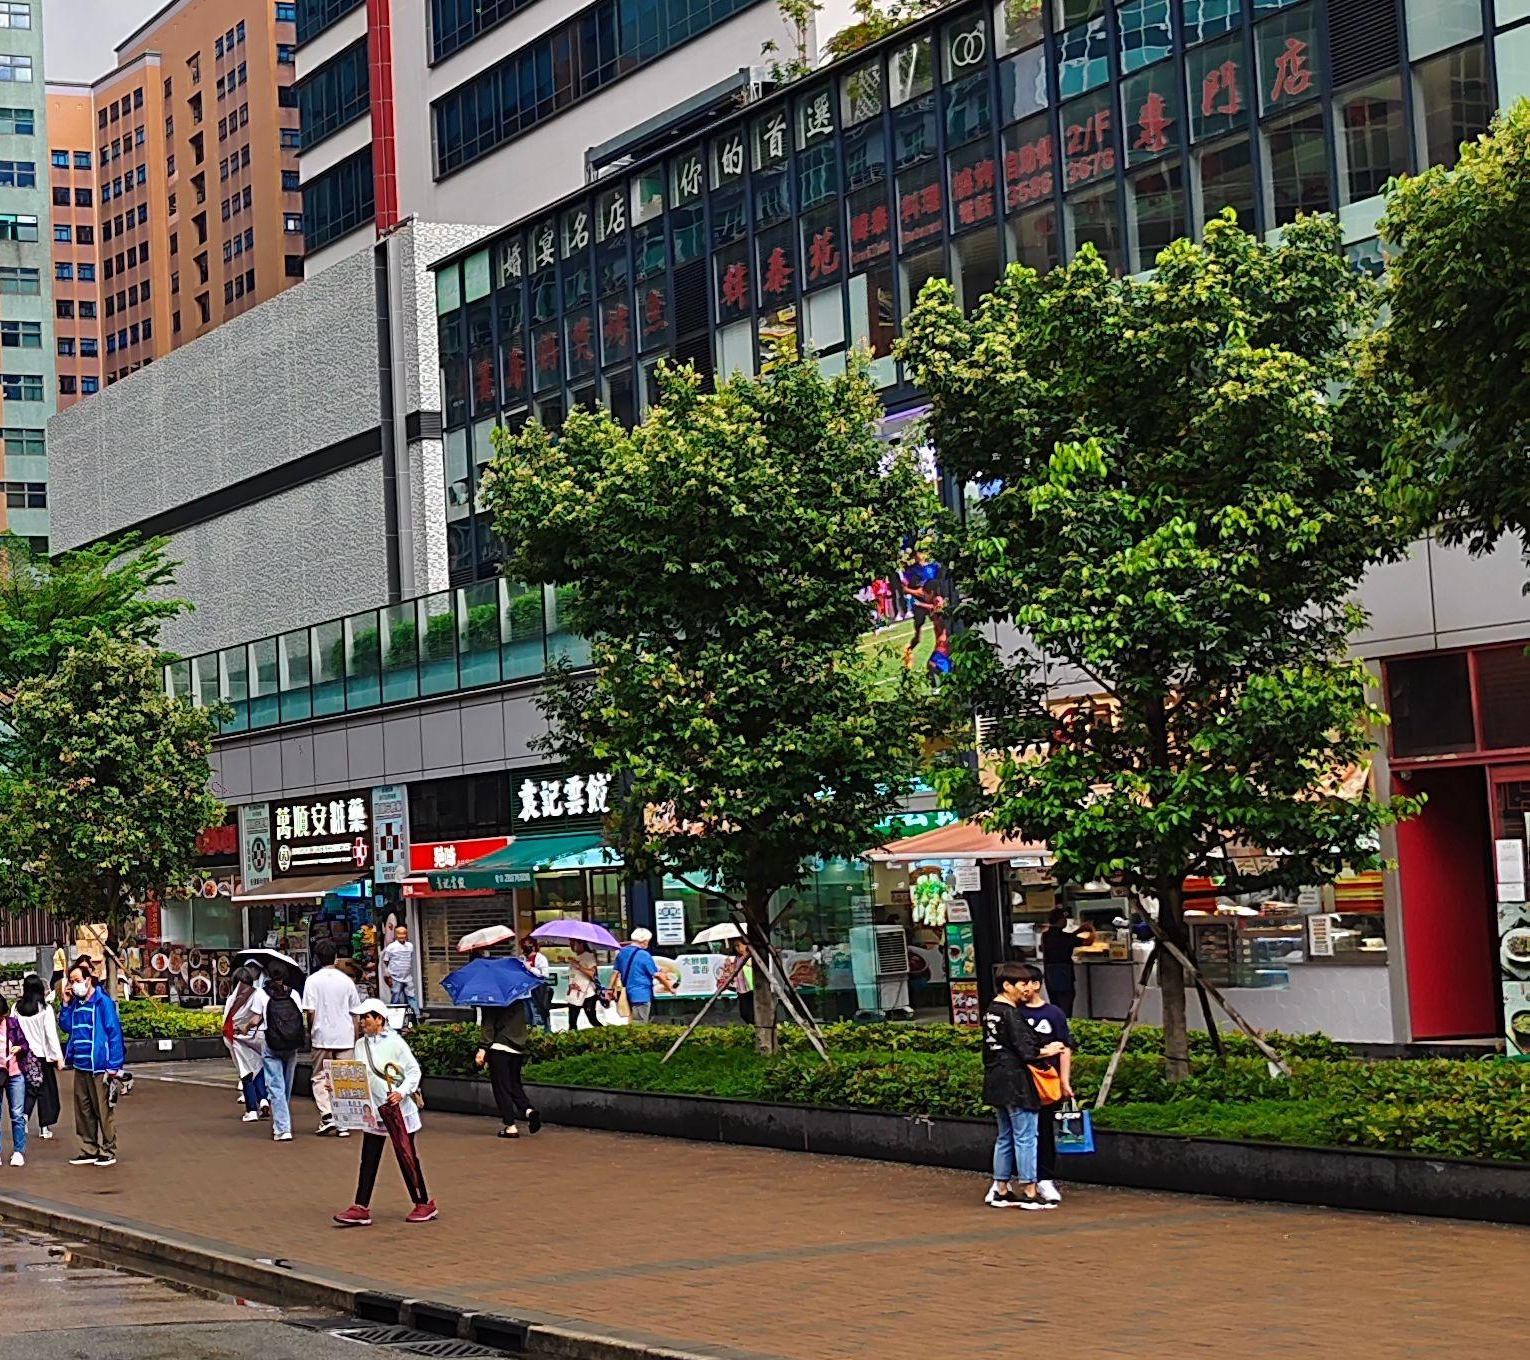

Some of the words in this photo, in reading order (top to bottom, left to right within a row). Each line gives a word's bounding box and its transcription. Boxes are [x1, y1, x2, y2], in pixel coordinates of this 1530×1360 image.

[680, 92, 834, 196] 你的首選
[1065, 109, 1111, 155] 2/F
[503, 192, 626, 277] 婚宴名店
